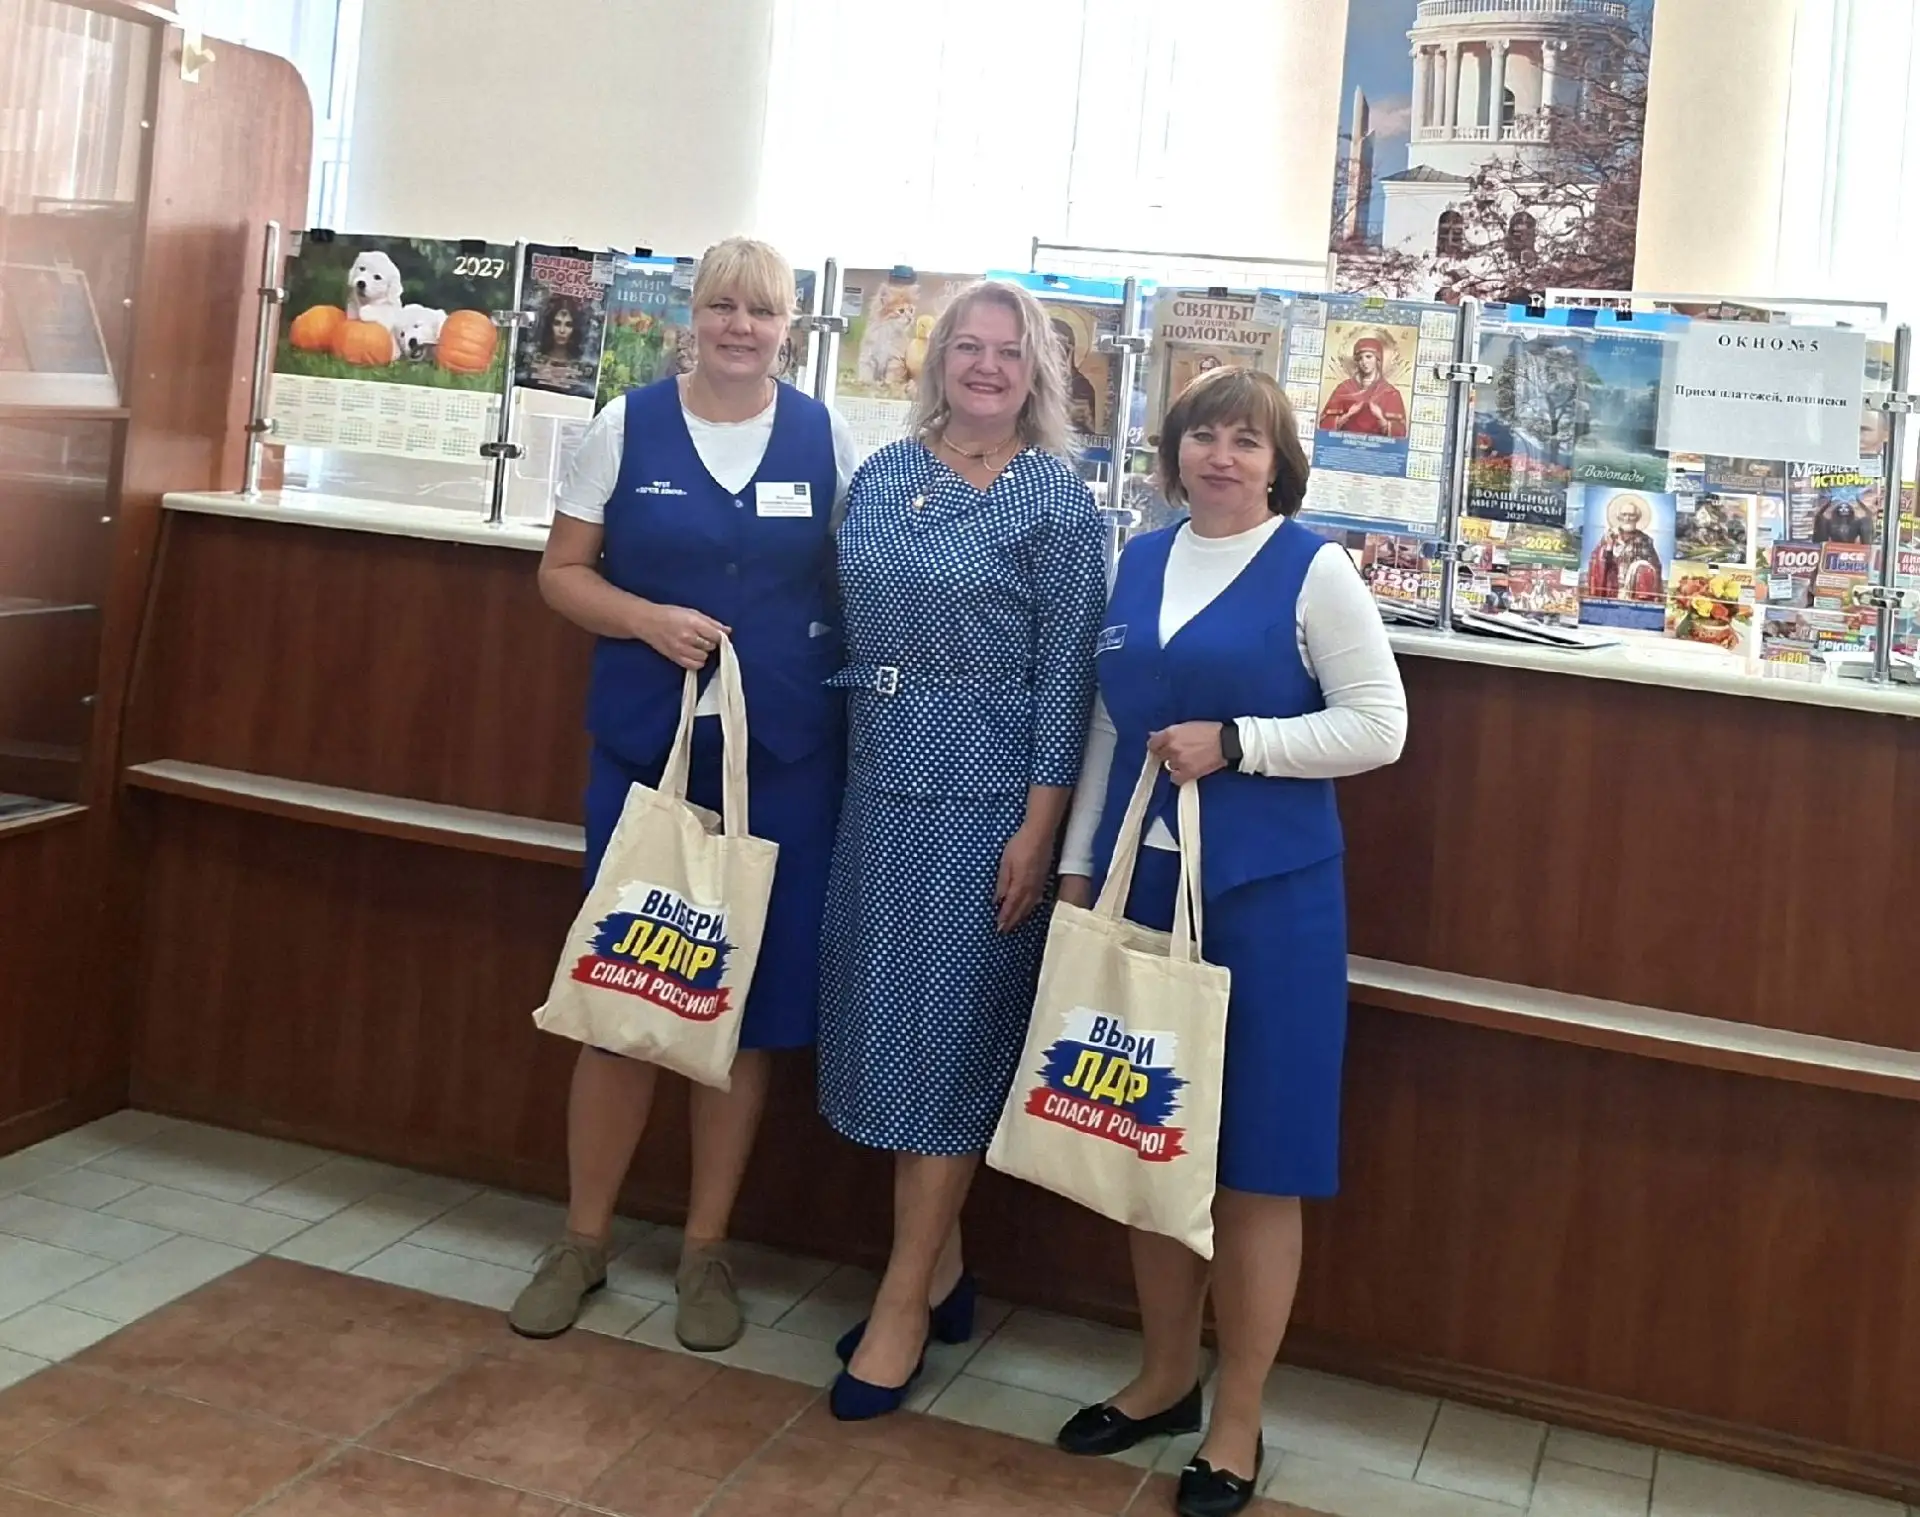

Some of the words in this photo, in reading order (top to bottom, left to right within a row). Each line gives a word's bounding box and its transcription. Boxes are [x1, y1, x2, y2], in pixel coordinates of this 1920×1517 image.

[453, 256, 505, 279] 2027
[532, 254, 594, 273] КАЛЕНДАР
[531, 267, 604, 289] ГОРОСКО
[1161, 324, 1272, 345] ПОМОГАЮТ
[1674, 384, 1716, 398] Прием
[1581, 464, 1646, 483] Водопады
[1470, 499, 1498, 509] МИР
[1500, 501, 1563, 517] ПРИРОДЫ
[1473, 489, 1559, 506] ВОЛШЕБНЫЙ
[1776, 551, 1820, 566] 1000
[640, 889, 725, 941] ВЫБЕРИ
[612, 919, 717, 981] ЛДПР
[590, 961, 650, 991] СПАСИ
[648, 978, 719, 1015] РОССИЮ!
[1043, 1094, 1105, 1129] СПАСИ
